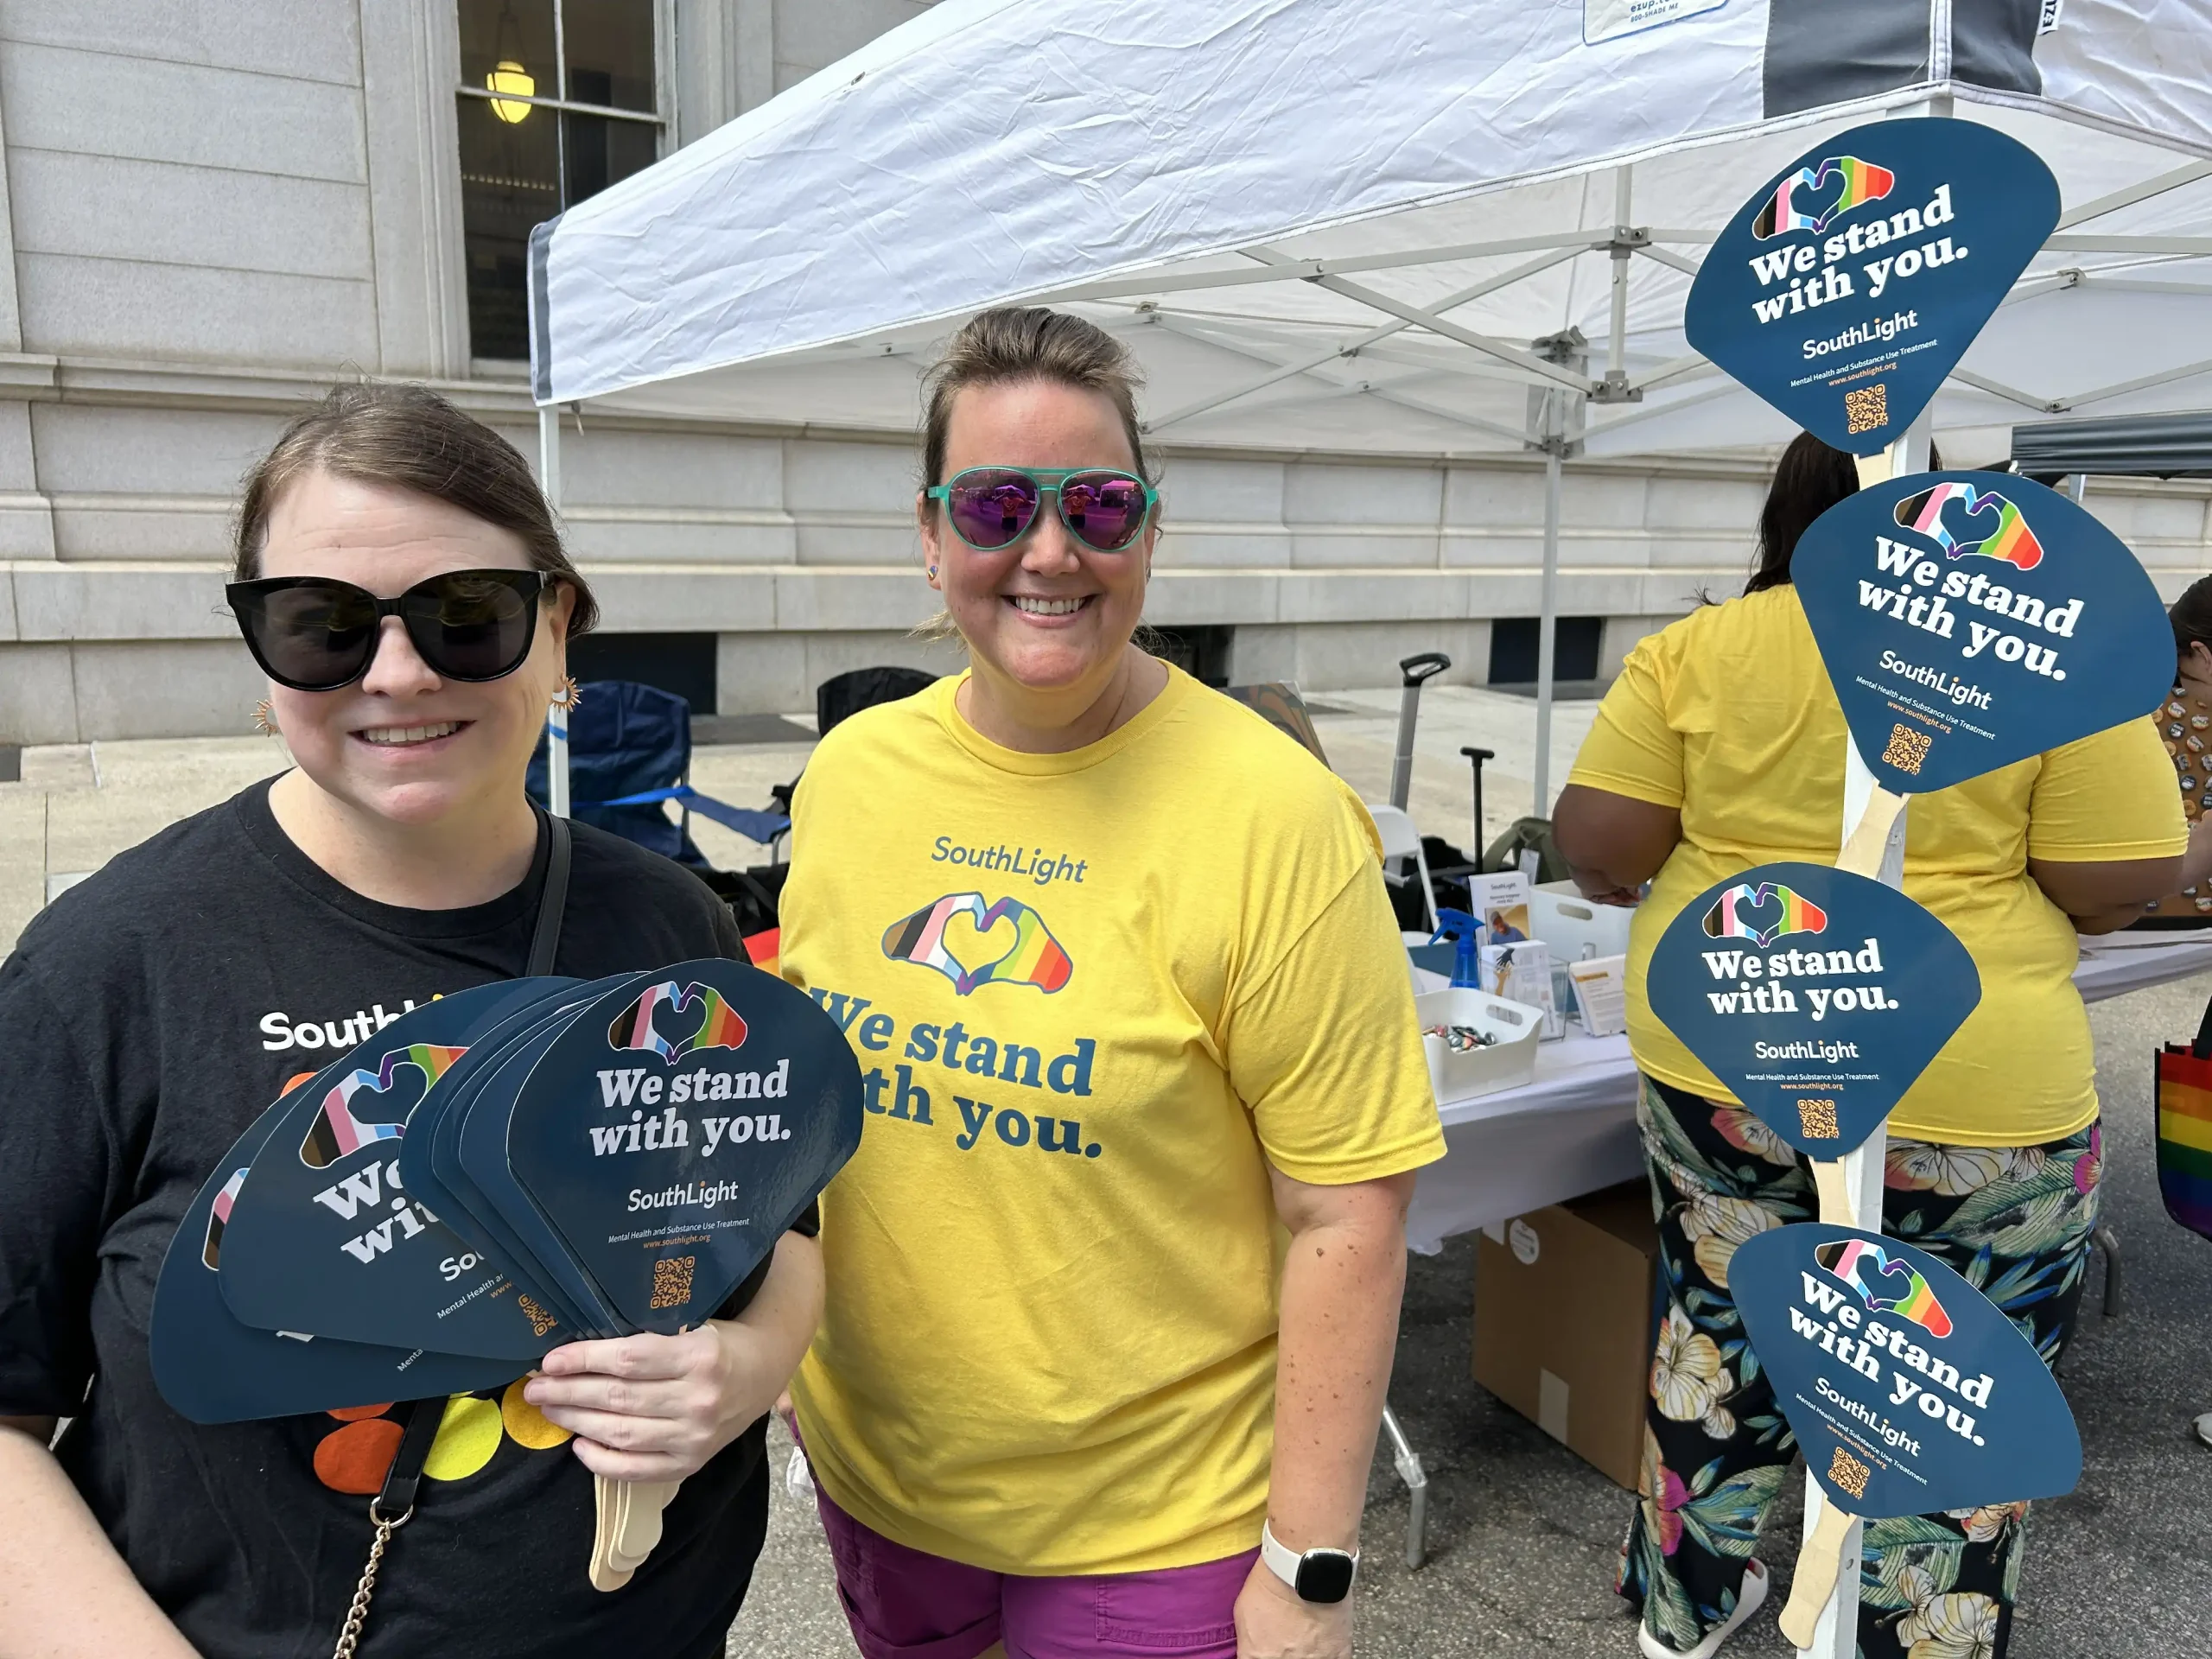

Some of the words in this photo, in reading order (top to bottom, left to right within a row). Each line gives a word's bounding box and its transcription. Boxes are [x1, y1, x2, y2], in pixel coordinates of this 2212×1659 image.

[1669, 3, 1678, 11] ME
[1749, 245, 1816, 286] We
[1823, 184, 1955, 264] stand
[1752, 265, 1855, 324] with
[1864, 237, 1968, 298] you.
[1802, 309, 1918, 359] SouthLight
[1790, 375, 1813, 387] Mental
[1813, 368, 1835, 381] Health
[1836, 364, 1849, 375] and
[1850, 355, 1885, 371] Substance
[1885, 350, 1899, 359] Use
[1900, 339, 1938, 356] Treatment
[1828, 362, 1897, 386] www.southlight.org
[1876, 536, 1939, 587] We
[1941, 570, 2085, 638] stand
[1859, 580, 1955, 639] with
[1961, 620, 2067, 681] you.
[1879, 650, 1993, 710] SouthLight
[1856, 676, 1878, 690] Mental
[1878, 684, 1898, 699] Health
[1898, 694, 1912, 704] and
[1912, 700, 1946, 719] Substance
[1946, 714, 1959, 725] Use
[1960, 720, 1996, 741] Treatment
[1887, 701, 1952, 734] www.southlight.org
[931, 836, 1088, 886] SouthLight
[1701, 950, 1763, 980] We
[1769, 938, 1884, 977] stand
[260, 994, 443, 1051] South
[1707, 980, 1799, 1014] with
[1805, 986, 1899, 1021] you.
[905, 1021, 1096, 1096] stand
[1755, 1039, 1859, 1064] SouthLight
[596, 1068, 664, 1108] We
[669, 1058, 790, 1103] stand
[1780, 1082, 1844, 1090] www.southlight.org
[589, 1107, 689, 1156] with
[701, 1114, 791, 1157] you.
[863, 1064, 934, 1126] th
[952, 1096, 1102, 1159] you.
[627, 1180, 739, 1212] SouthLight
[608, 1232, 630, 1244] Mental
[631, 1228, 652, 1240] Health
[652, 1226, 666, 1236] and
[667, 1223, 702, 1235] Substance
[702, 1221, 715, 1230] Use
[716, 1217, 750, 1228] Treatment
[643, 1234, 711, 1249] www.southlight.org
[436, 1296, 467, 1319] Mental
[467, 1279, 495, 1300] Health
[397, 1348, 423, 1372] Menta
[1802, 1271, 1861, 1330] We
[1865, 1321, 1994, 1409] stand
[1789, 1306, 1880, 1383] with
[1889, 1371, 1986, 1446] you.
[1796, 1393, 1816, 1410] Mental
[1816, 1407, 1836, 1424] Health
[1836, 1421, 1849, 1433] and
[1849, 1429, 1880, 1455] Substance
[1880, 1452, 1893, 1463] Use
[1894, 1460, 1928, 1485] Treatment
[1815, 1376, 1921, 1458] SouthLight
[1827, 1424, 1887, 1470] www.southlight.org
